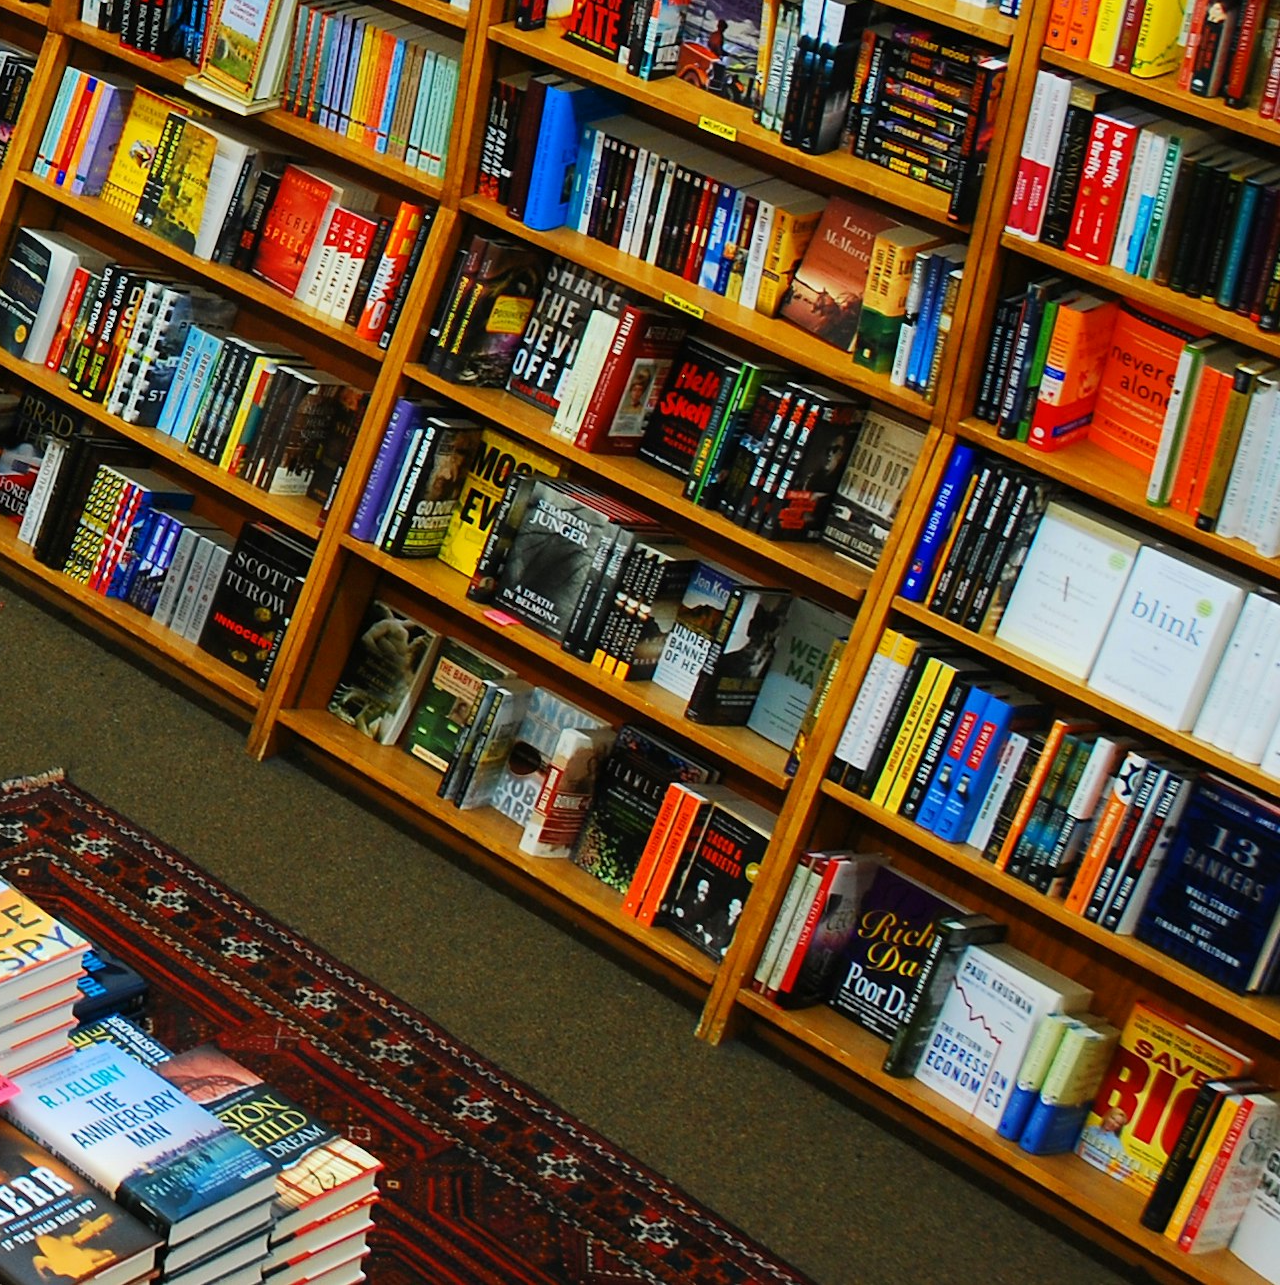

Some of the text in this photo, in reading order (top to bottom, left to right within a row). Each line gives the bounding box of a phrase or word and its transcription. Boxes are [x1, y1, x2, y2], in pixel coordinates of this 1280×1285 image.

[842, 215, 874, 239] Larry
[1109, 343, 1166, 380] never
[527, 510, 591, 548] JUNGER
[922, 482, 956, 545] TRUE NORTH
[224, 571, 287, 618] TUROW
[234, 547, 296, 597] SCOTT
[1131, 593, 1205, 647] blink
[1207, 822, 1259, 869] 13
[1183, 847, 1266, 902] BANKERS
[857, 909, 935, 952] Rich
[1153, 915, 1241, 968] FINANCIAL MELTDOWN
[842, 961, 881, 1006] Poor
[961, 959, 1034, 1016] PAUL KRUGMAN
[70, 1088, 183, 1150] ANNIVERSARY
[86, 1093, 121, 1115] THE
[124, 1122, 172, 1148] MAN
[266, 1124, 326, 1159] DREAM
